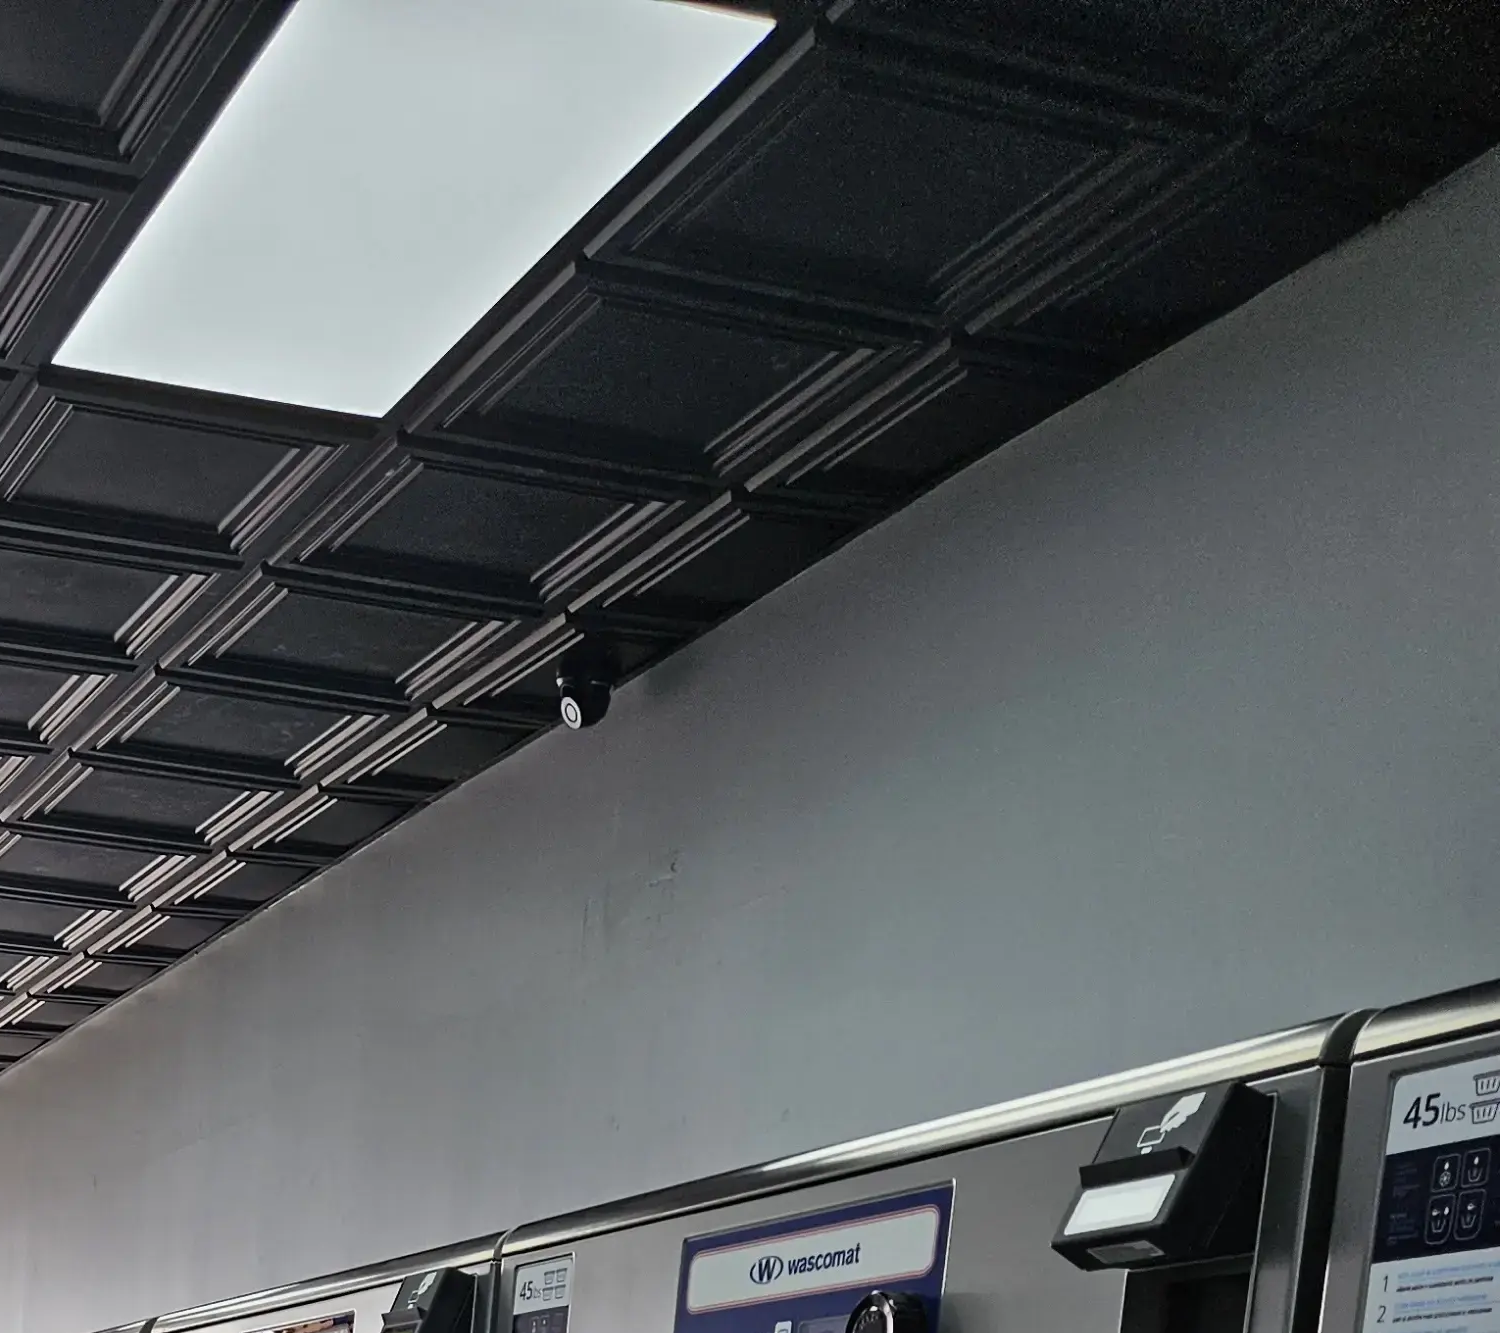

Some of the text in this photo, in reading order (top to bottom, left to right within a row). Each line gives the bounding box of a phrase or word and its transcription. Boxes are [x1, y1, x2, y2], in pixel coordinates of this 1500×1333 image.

[787, 1243, 861, 1276] wascomat
[1383, 1275, 1389, 1292] 1
[1376, 1305, 1387, 1323] 2
